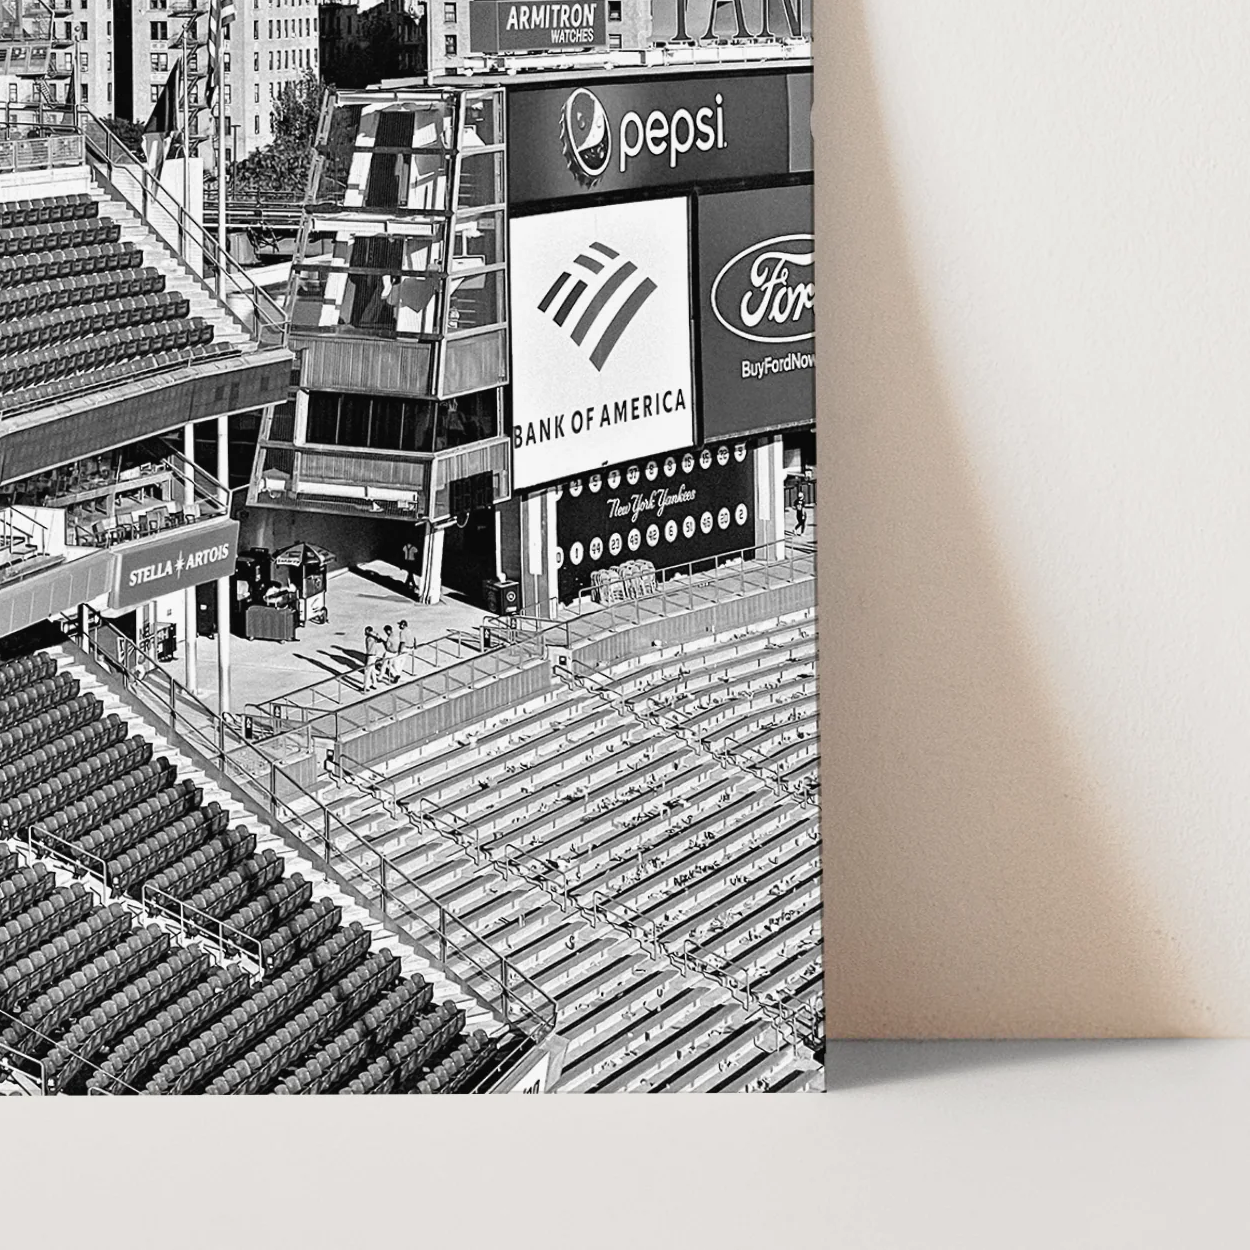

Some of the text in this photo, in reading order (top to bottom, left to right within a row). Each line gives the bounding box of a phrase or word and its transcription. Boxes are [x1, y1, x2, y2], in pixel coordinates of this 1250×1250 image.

[506, 3, 597, 30] ARMITRON
[551, 28, 594, 43] WATCHES
[619, 93, 728, 172] pepsi
[513, 388, 686, 449] BANK OF AMERICA
[606, 483, 697, 523] New York Yankees
[129, 543, 229, 587] STELLA ARTOIS
